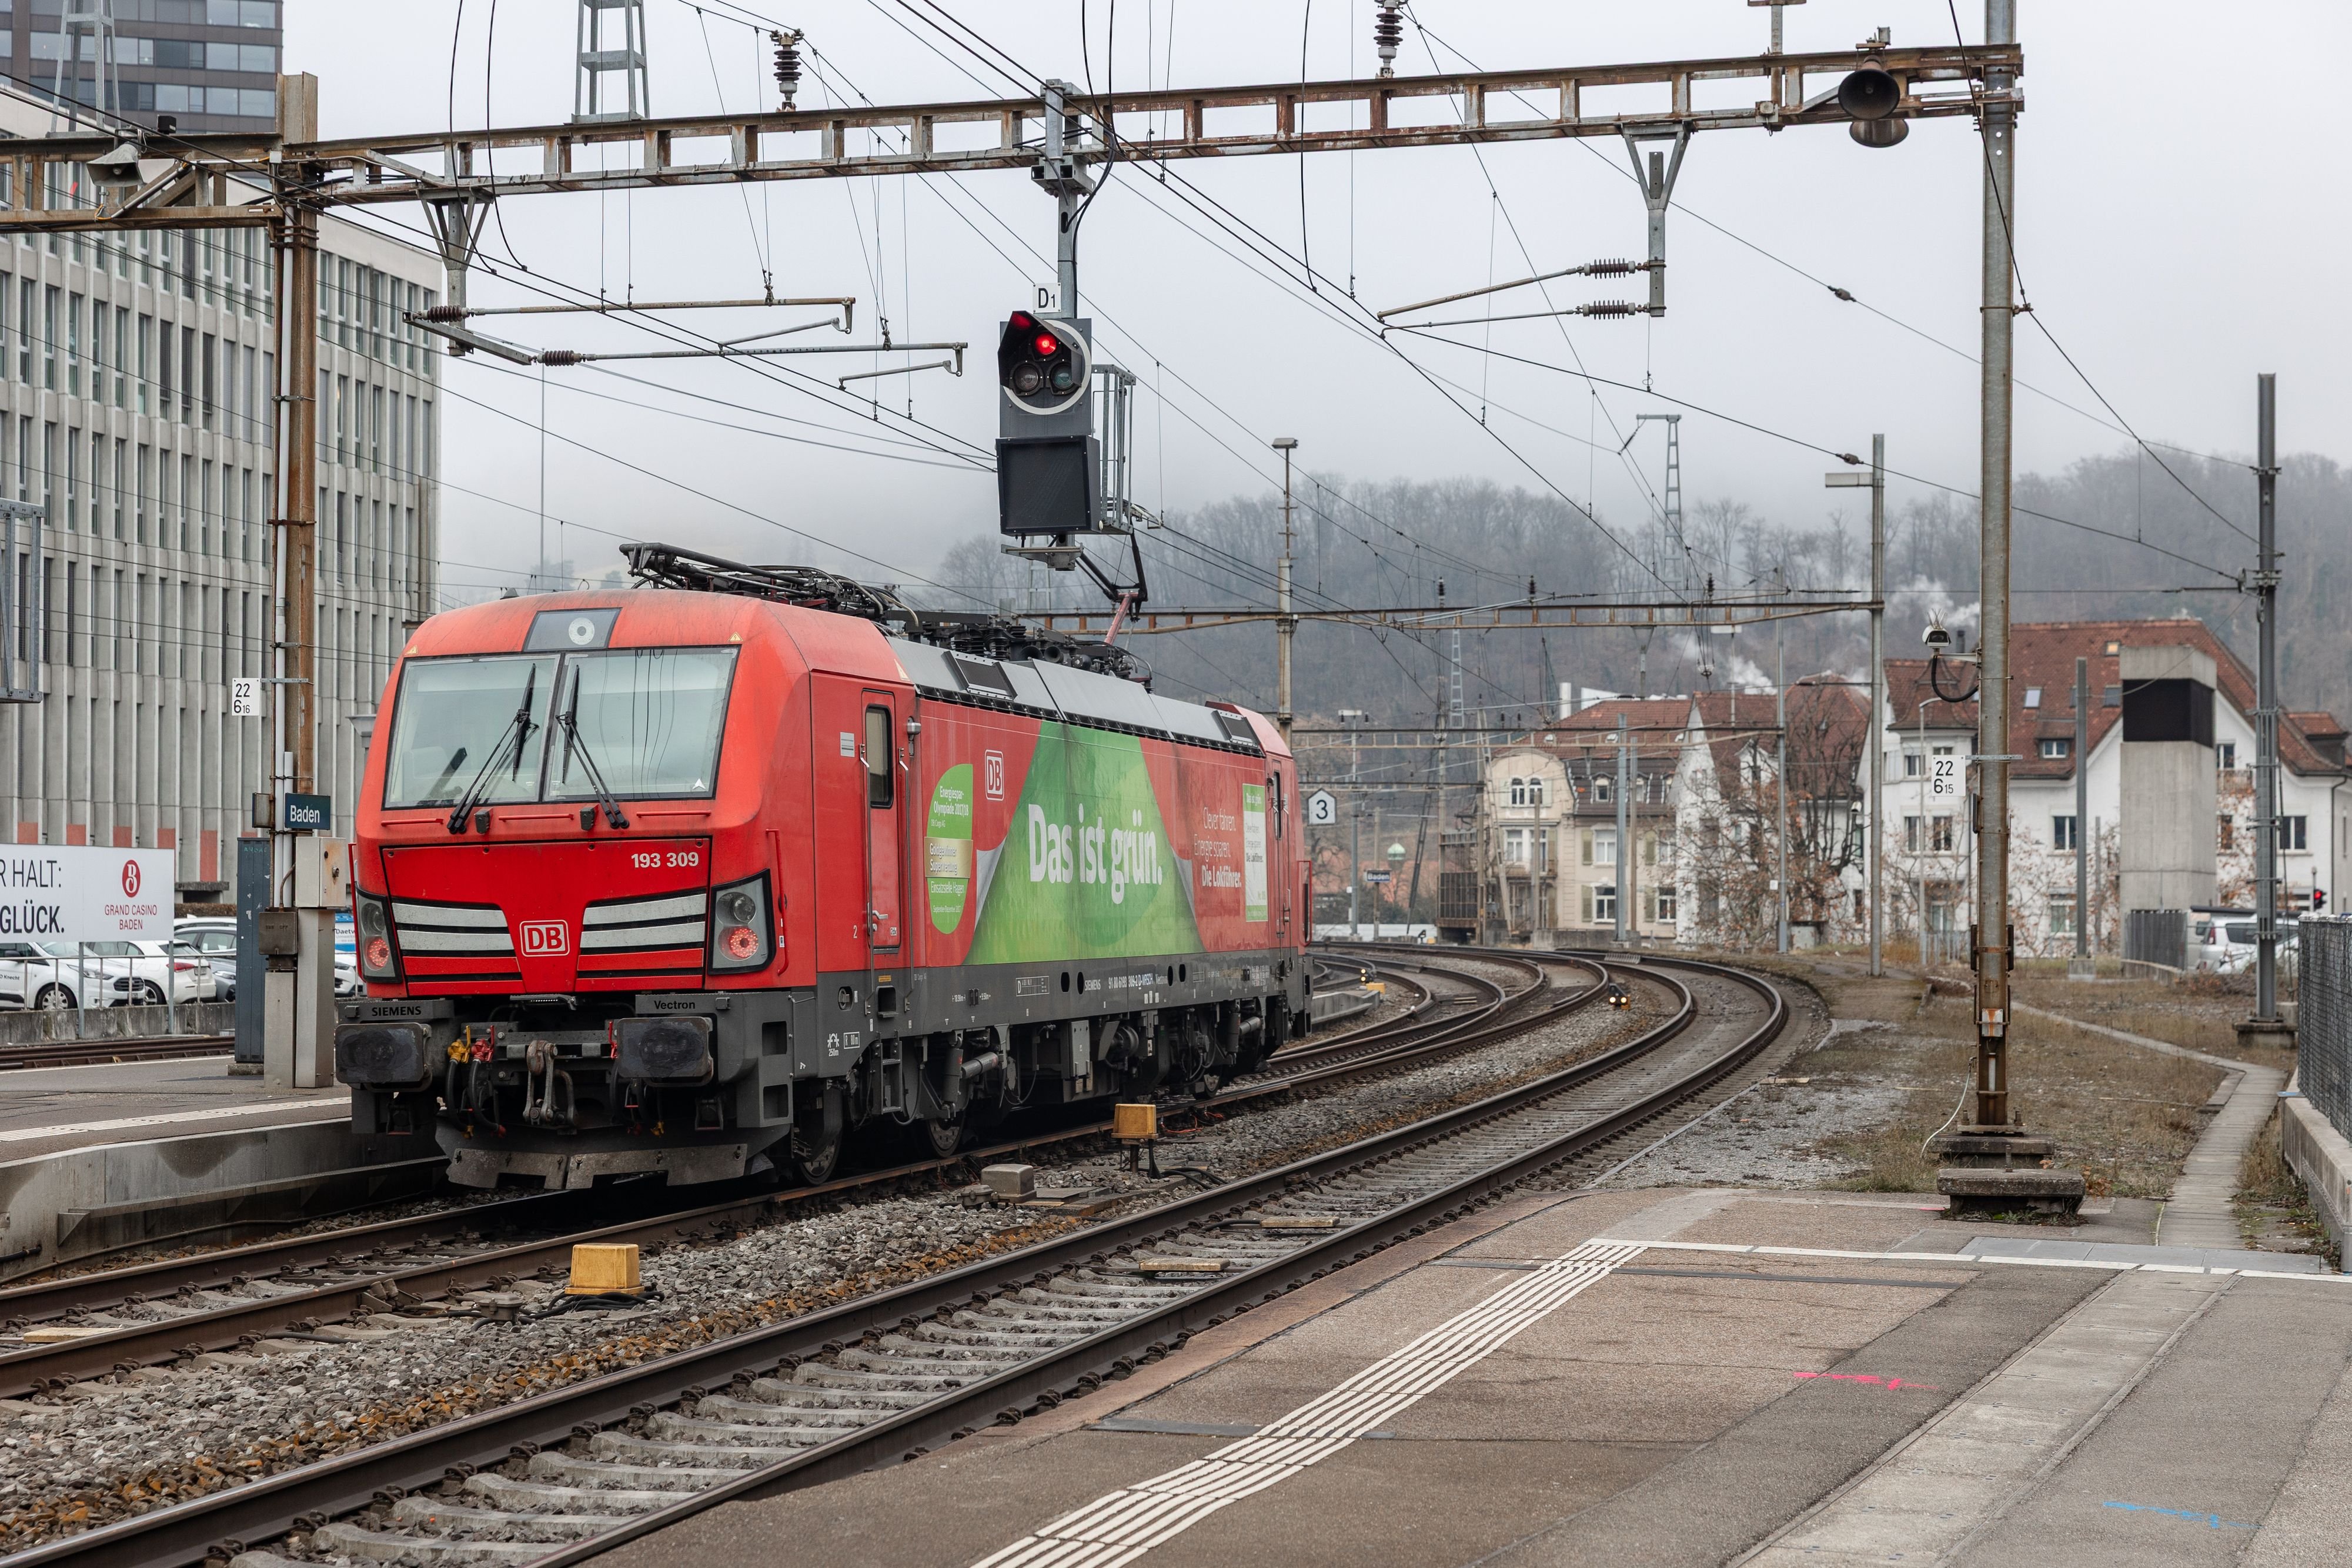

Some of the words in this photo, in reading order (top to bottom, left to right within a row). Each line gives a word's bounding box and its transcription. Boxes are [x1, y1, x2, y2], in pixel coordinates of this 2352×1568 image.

[1038, 287, 1055, 308] D1
[235, 683, 250, 697] 22
[987, 758, 1002, 793] DB
[1935, 760, 1953, 776] 22
[940, 785, 964, 802] Energiespar-
[290, 804, 320, 823] Baden
[933, 801, 954, 817] Olympiade
[1316, 799, 1328, 820] 3
[1203, 807, 1218, 830] Clever
[1219, 808, 1237, 831] fahren.
[1028, 804, 1074, 884] Das
[1078, 803, 1107, 884] ist
[1111, 808, 1162, 904] grün.
[1194, 834, 1212, 862] Energie
[1213, 841, 1231, 862] sparen.
[631, 852, 661, 868] 193
[666, 851, 699, 868] 309
[12, 859, 62, 888] HALT:
[1201, 863, 1212, 887] Die
[1212, 865, 1242, 888] Lokführer.
[931, 881, 953, 893] Einsatzstelle
[953, 881, 964, 897] Hagen
[1, 899, 65, 934] GLÜCK.
[105, 904, 129, 916] GRAND
[131, 904, 157, 916] CASINO
[119, 919, 143, 930] BADEN
[853, 925, 857, 938] 2
[525, 925, 564, 951] DB
[1084, 979, 1101, 991] SIEMENS
[1108, 977, 1113, 989] 91
[1114, 977, 1118, 989] 80
[1118, 975, 1127, 988] 6193
[371, 1006, 422, 1017] SIEMENS
[653, 1000, 696, 1009] Vectron
[845, 1035, 848, 1046] R
[828, 1048, 839, 1057] 250m
